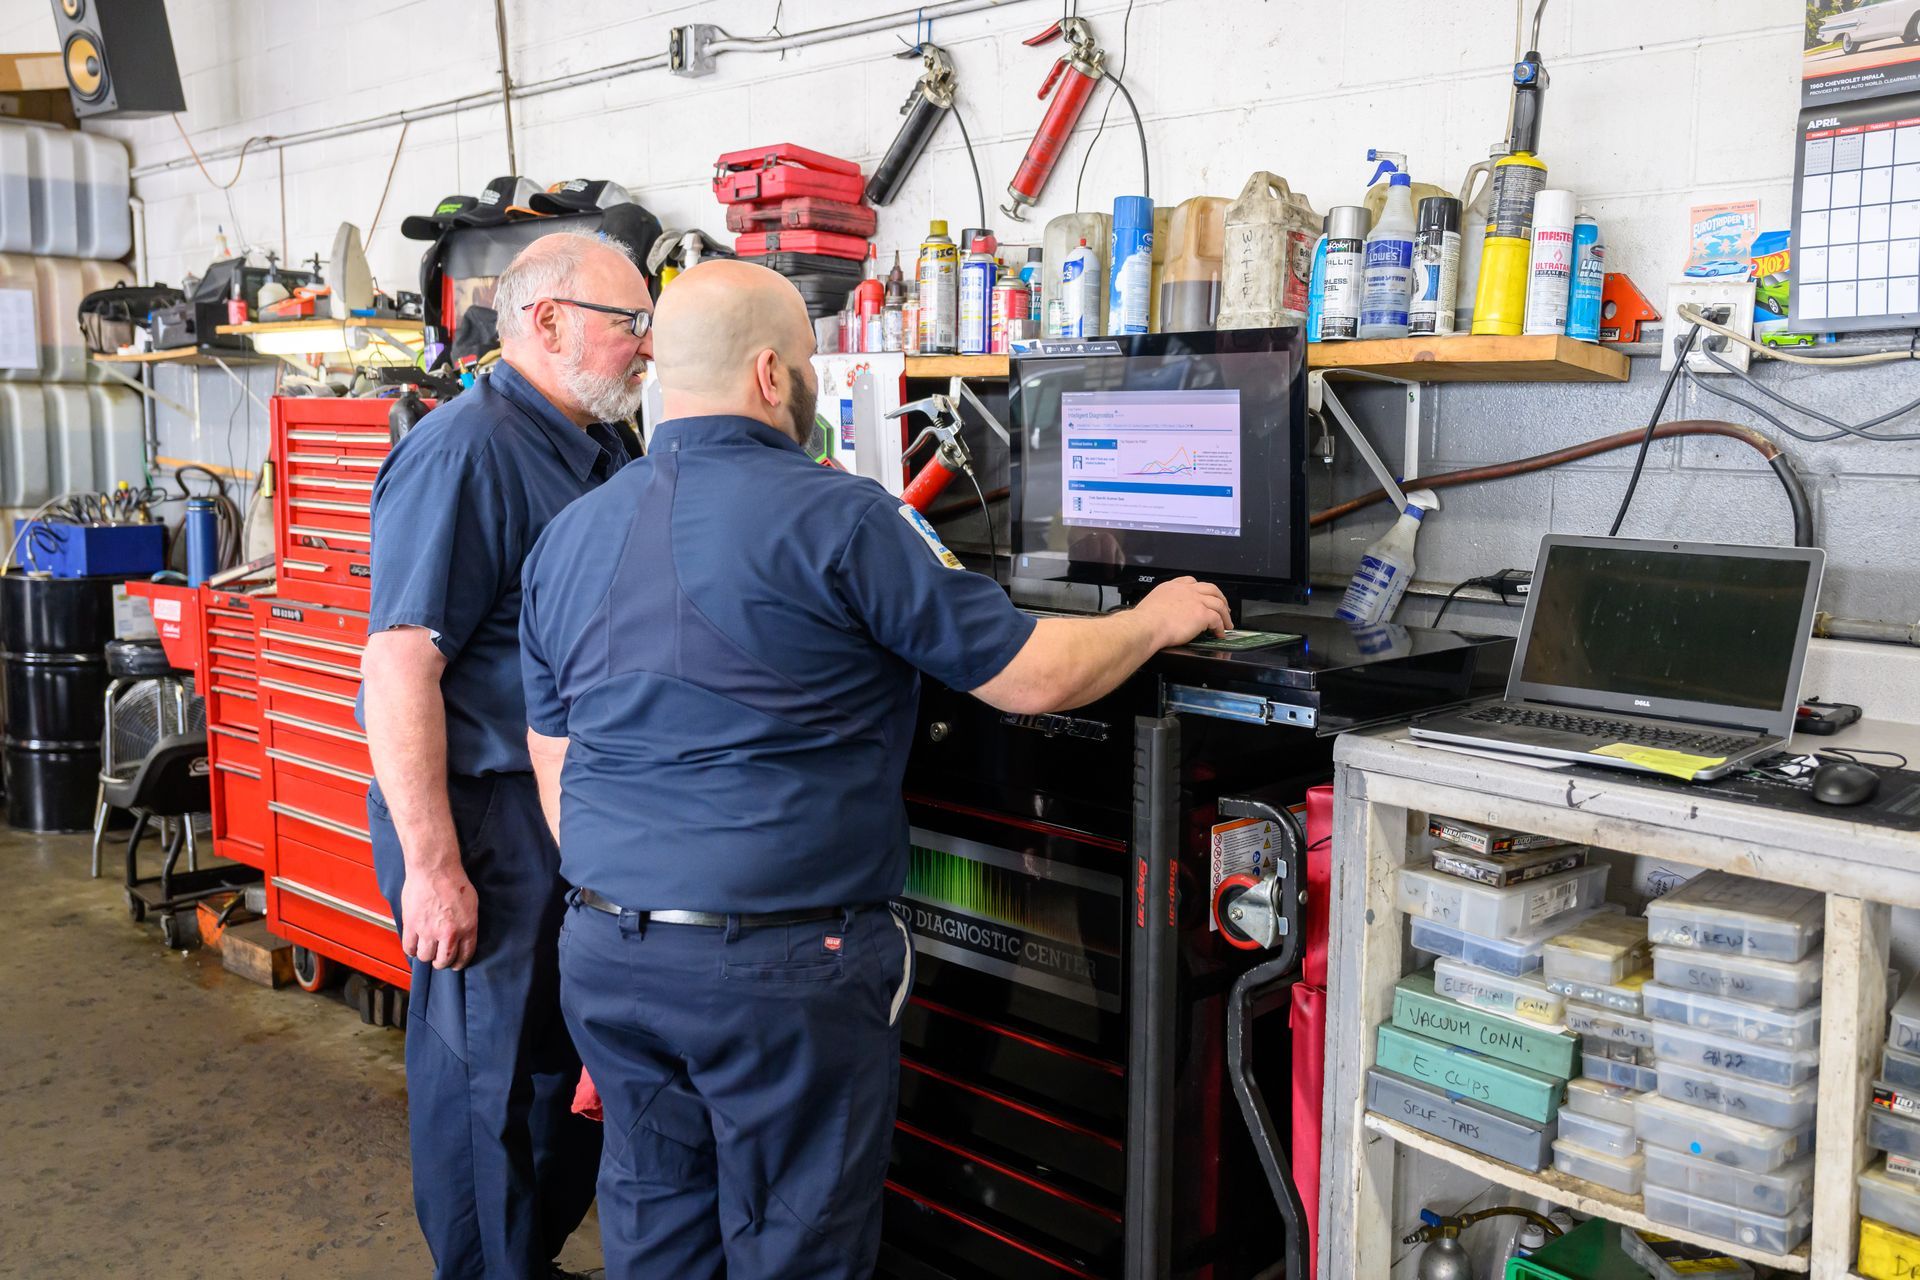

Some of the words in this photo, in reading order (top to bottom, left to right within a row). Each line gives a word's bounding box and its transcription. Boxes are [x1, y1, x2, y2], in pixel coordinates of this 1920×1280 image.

[1825, 76, 1860, 88] CHEVROLET
[1861, 72, 1885, 82] IMPALA
[1809, 88, 1832, 96] PROVIDED
[1807, 117, 1841, 130] APRIL
[1811, 131, 1828, 139] SUNDAY
[1693, 214, 1741, 237] EUROTRIPPER
[1537, 231, 1573, 243] MASTE
[1369, 250, 1398, 262] LOWE'S
[1240, 229, 1254, 299] WATER
[1535, 262, 1570, 272] ULTRATAN
[1138, 575, 1155, 583] acer
[1634, 699, 1651, 707] DELL
[1443, 827, 1460, 838] 1000
[1513, 836, 1531, 845] 1000
[915, 909, 1021, 956] DIAGNOSTIC
[1024, 941, 1097, 980] CENTER
[1409, 1007, 1471, 1036] VACUUM
[1479, 1025, 1531, 1054] CONN.
[1445, 1070, 1490, 1101] CLIPS
